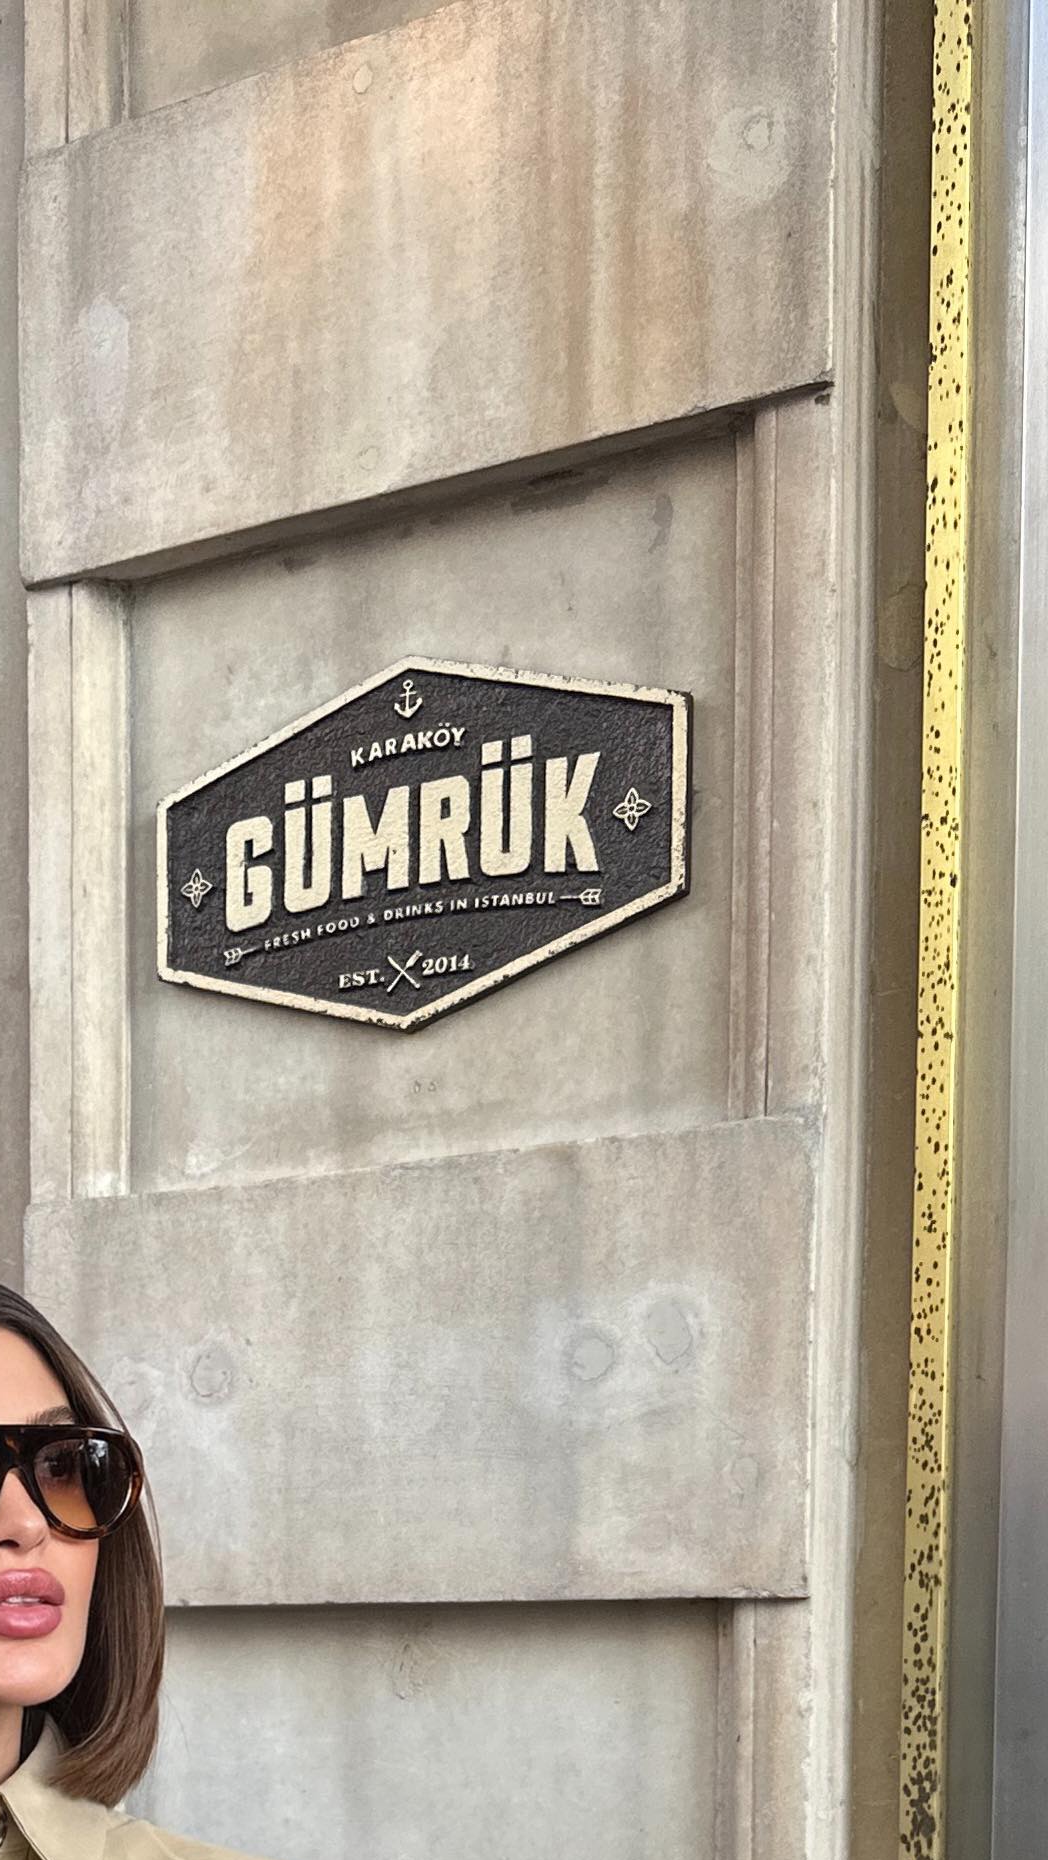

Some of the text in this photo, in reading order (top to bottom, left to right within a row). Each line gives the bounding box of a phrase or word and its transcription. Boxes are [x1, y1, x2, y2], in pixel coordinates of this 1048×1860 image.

[351, 723, 466, 767] KARAKÖY
[225, 734, 601, 932] GÜMRÜK
[264, 891, 556, 951] FRESH FOOD & DRINKS IN ISTANBUL
[338, 953, 472, 989] EST. 2014
